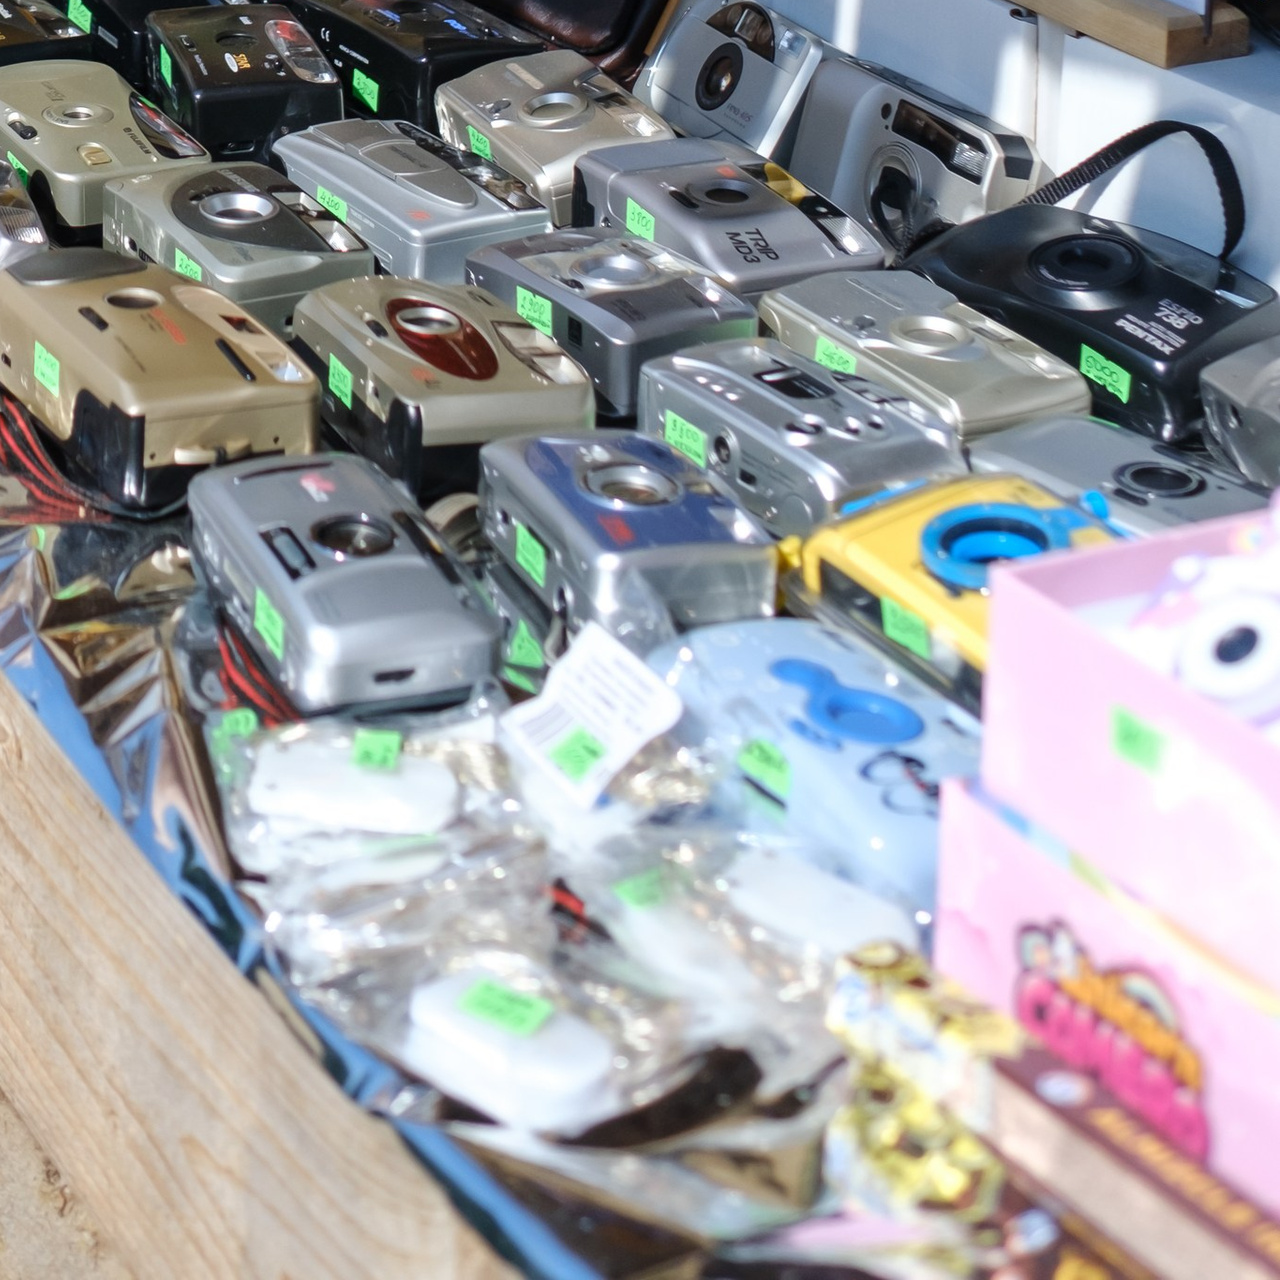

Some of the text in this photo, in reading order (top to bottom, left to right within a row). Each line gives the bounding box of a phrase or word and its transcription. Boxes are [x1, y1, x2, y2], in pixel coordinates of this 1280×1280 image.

[233, 53, 252, 70] STAR
[128, 132, 152, 155] FUJIFILM
[725, 231, 761, 264] MD3
[745, 227, 780, 261] TRIP
[1154, 306, 1190, 330] 738
[1158, 298, 1204, 325] ESPIO
[1114, 318, 1176, 356] PENTAX
[1085, 355, 1120, 384] 6000
